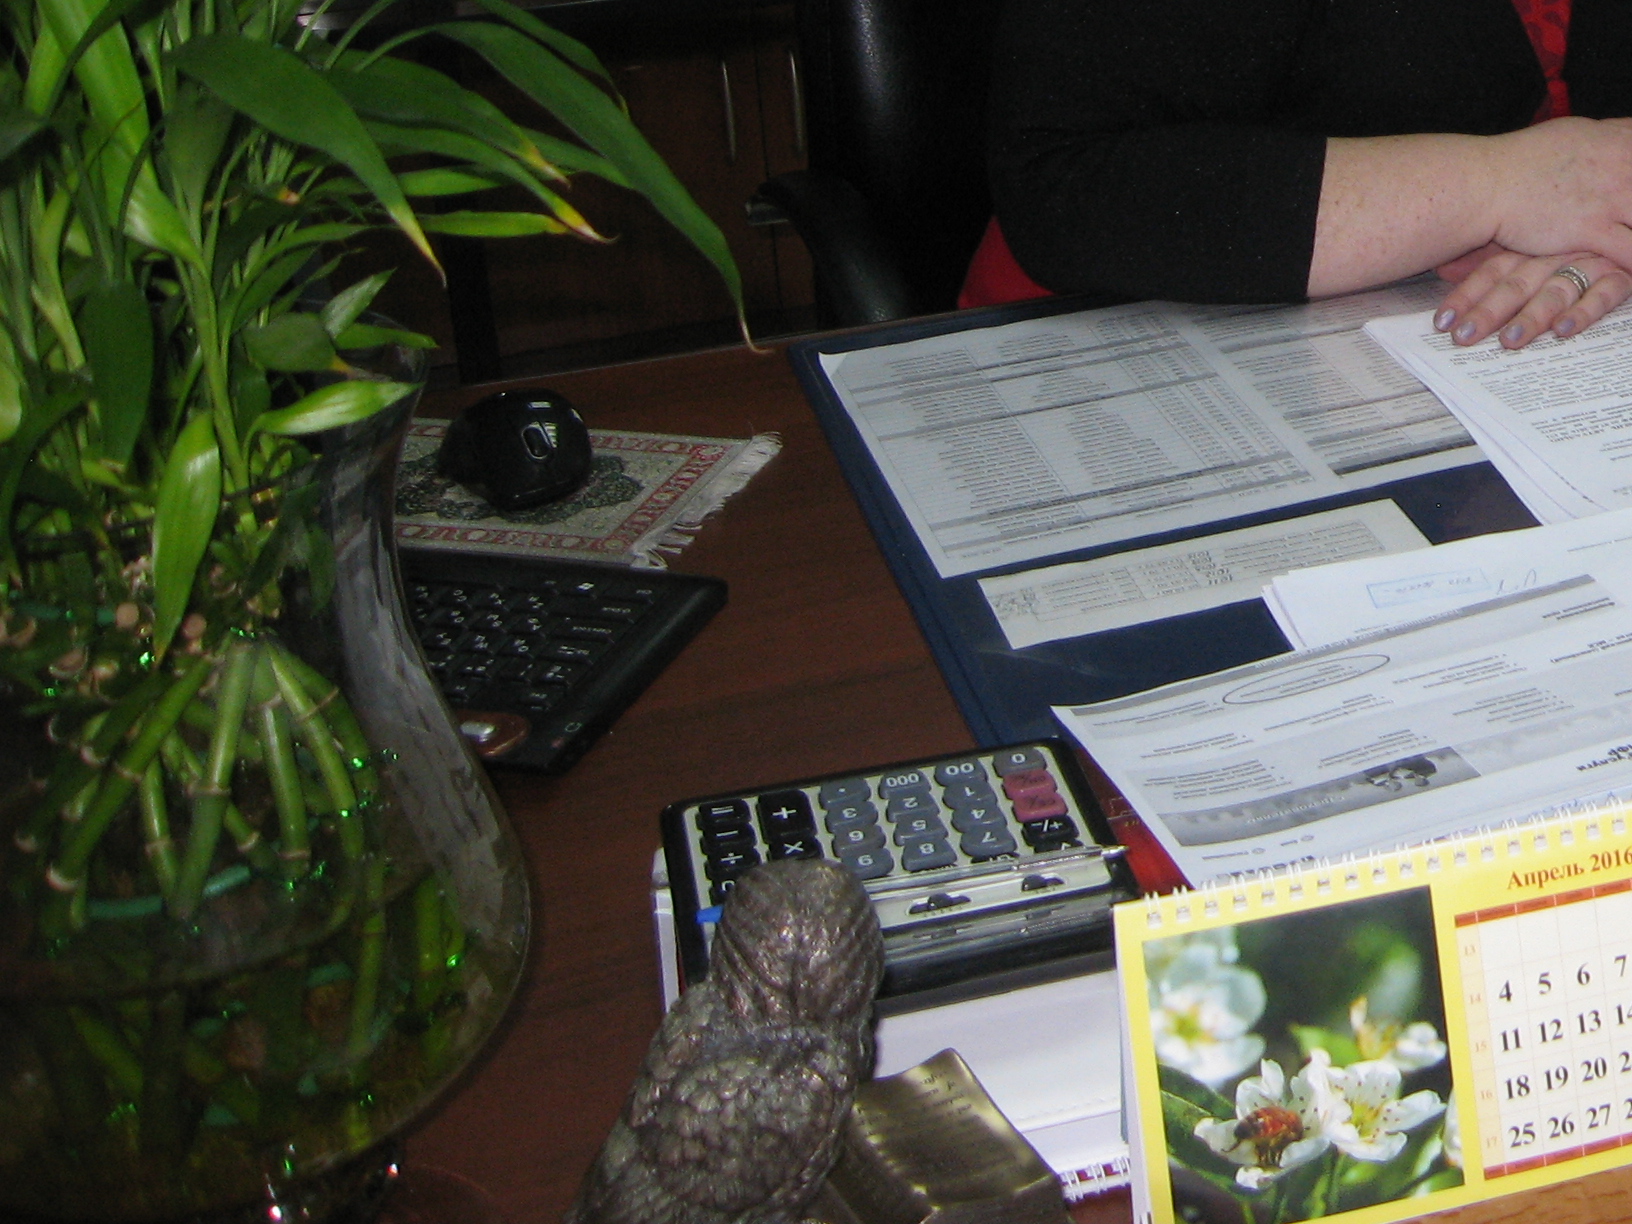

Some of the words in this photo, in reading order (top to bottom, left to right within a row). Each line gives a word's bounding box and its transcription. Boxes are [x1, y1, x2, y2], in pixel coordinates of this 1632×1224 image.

[1506, 865, 1585, 889] Апрель
[1499, 980, 1512, 1002] 4
[1538, 972, 1552, 995] 5
[1577, 963, 1590, 985] 6
[1614, 955, 1628, 977] 7
[1501, 1028, 1521, 1052] 11
[1538, 1019, 1564, 1042] 12
[1577, 1010, 1601, 1034] 13
[1505, 1075, 1530, 1100] 18
[1544, 1066, 1569, 1090] 19
[1582, 1057, 1607, 1082] 20
[1509, 1122, 1536, 1147] 25
[1548, 1113, 1574, 1138] 26
[1586, 1104, 1611, 1129] 27
